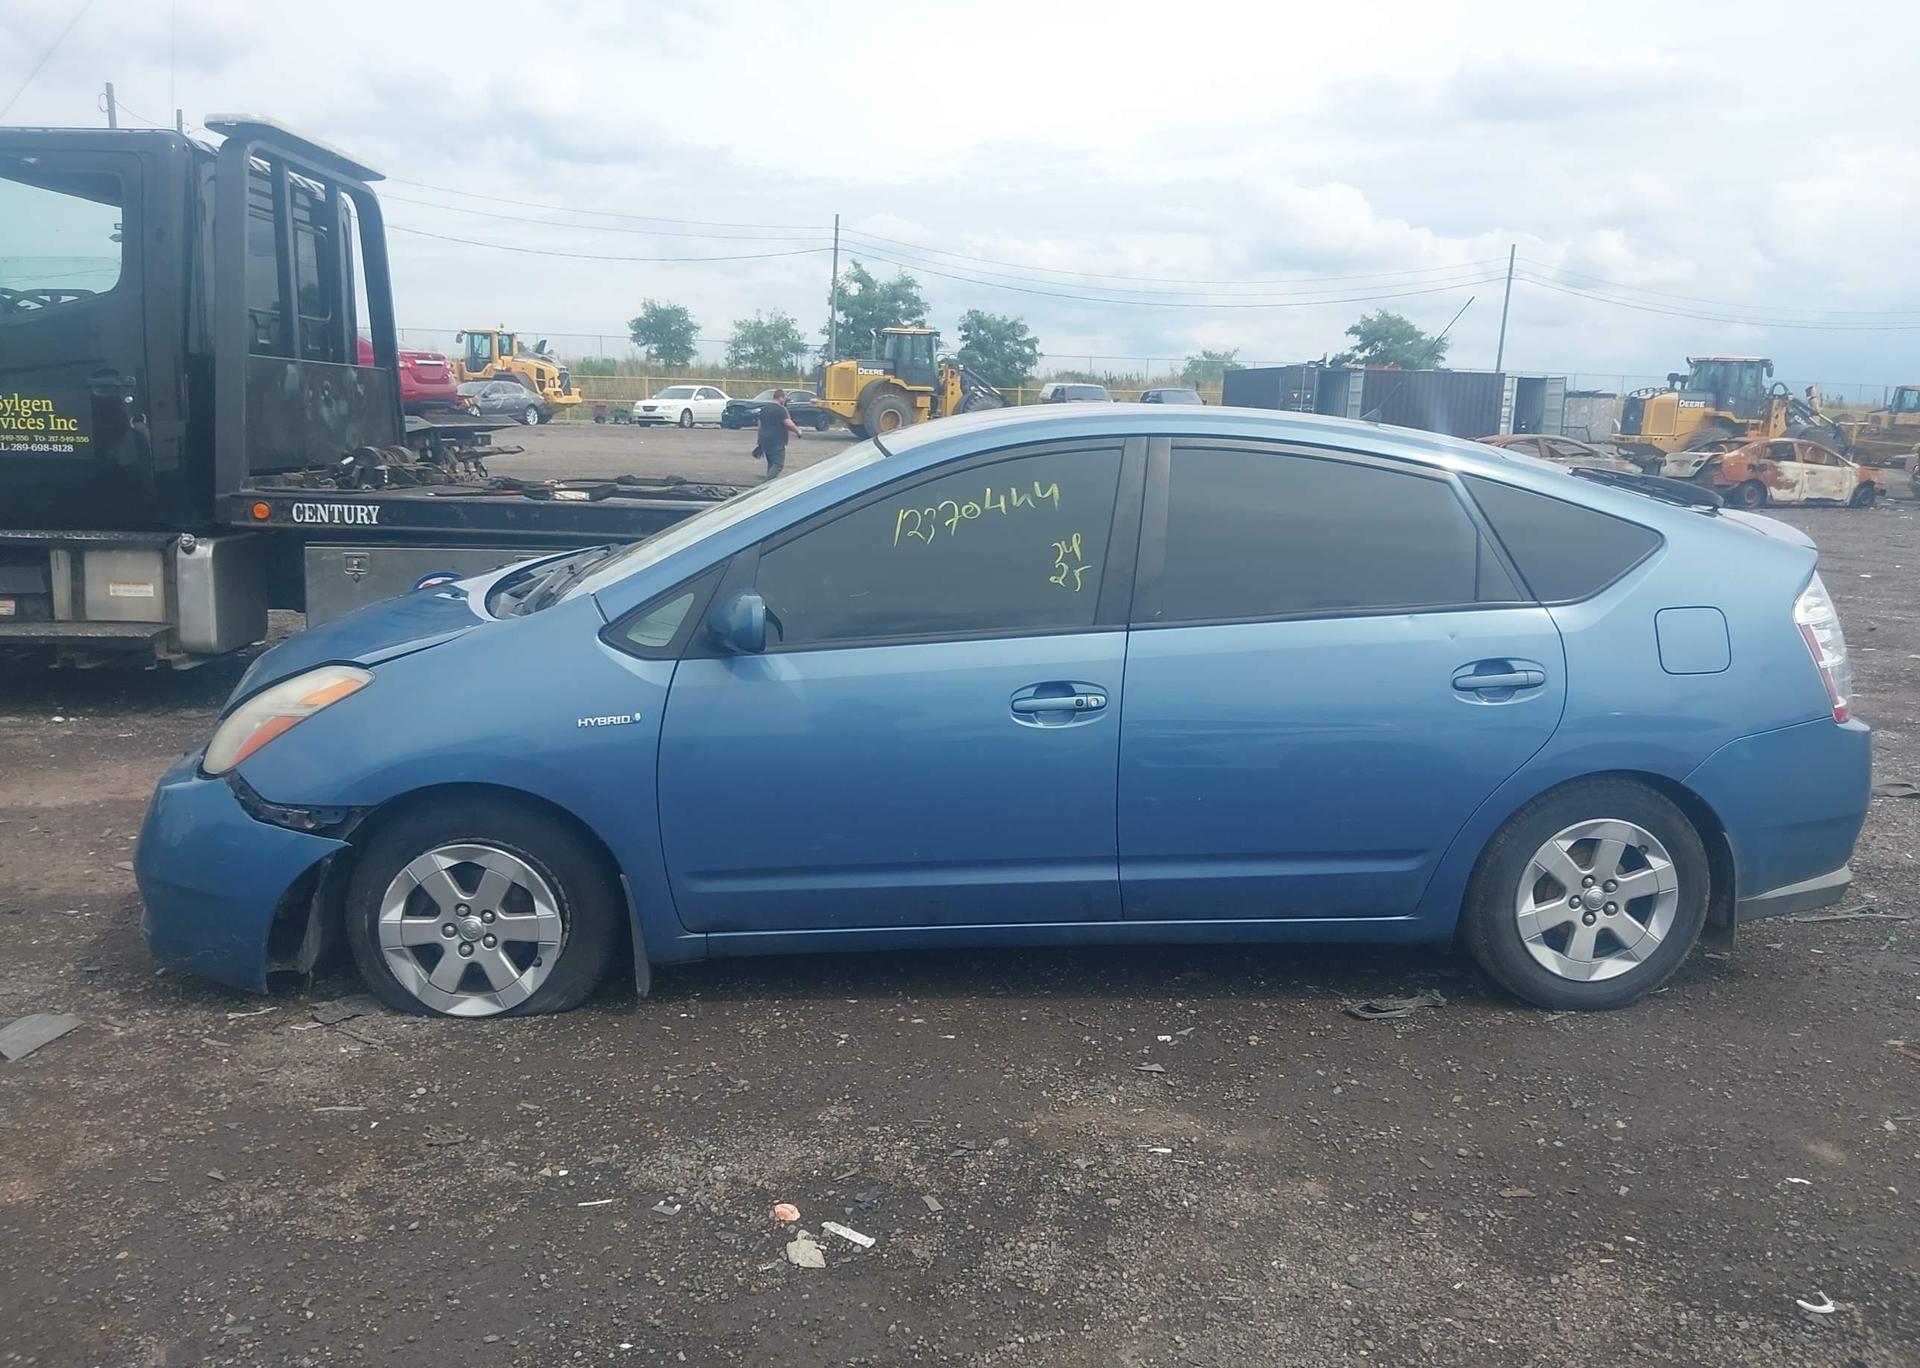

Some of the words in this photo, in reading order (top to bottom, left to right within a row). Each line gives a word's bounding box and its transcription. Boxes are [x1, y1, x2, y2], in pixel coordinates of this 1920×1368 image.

[857, 367, 885, 376] DEERE
[1678, 399, 1706, 408] DEERE
[49, 414, 79, 431] Inc
[292, 502, 380, 524] CENTURY
[577, 715, 631, 727] HYBRID
